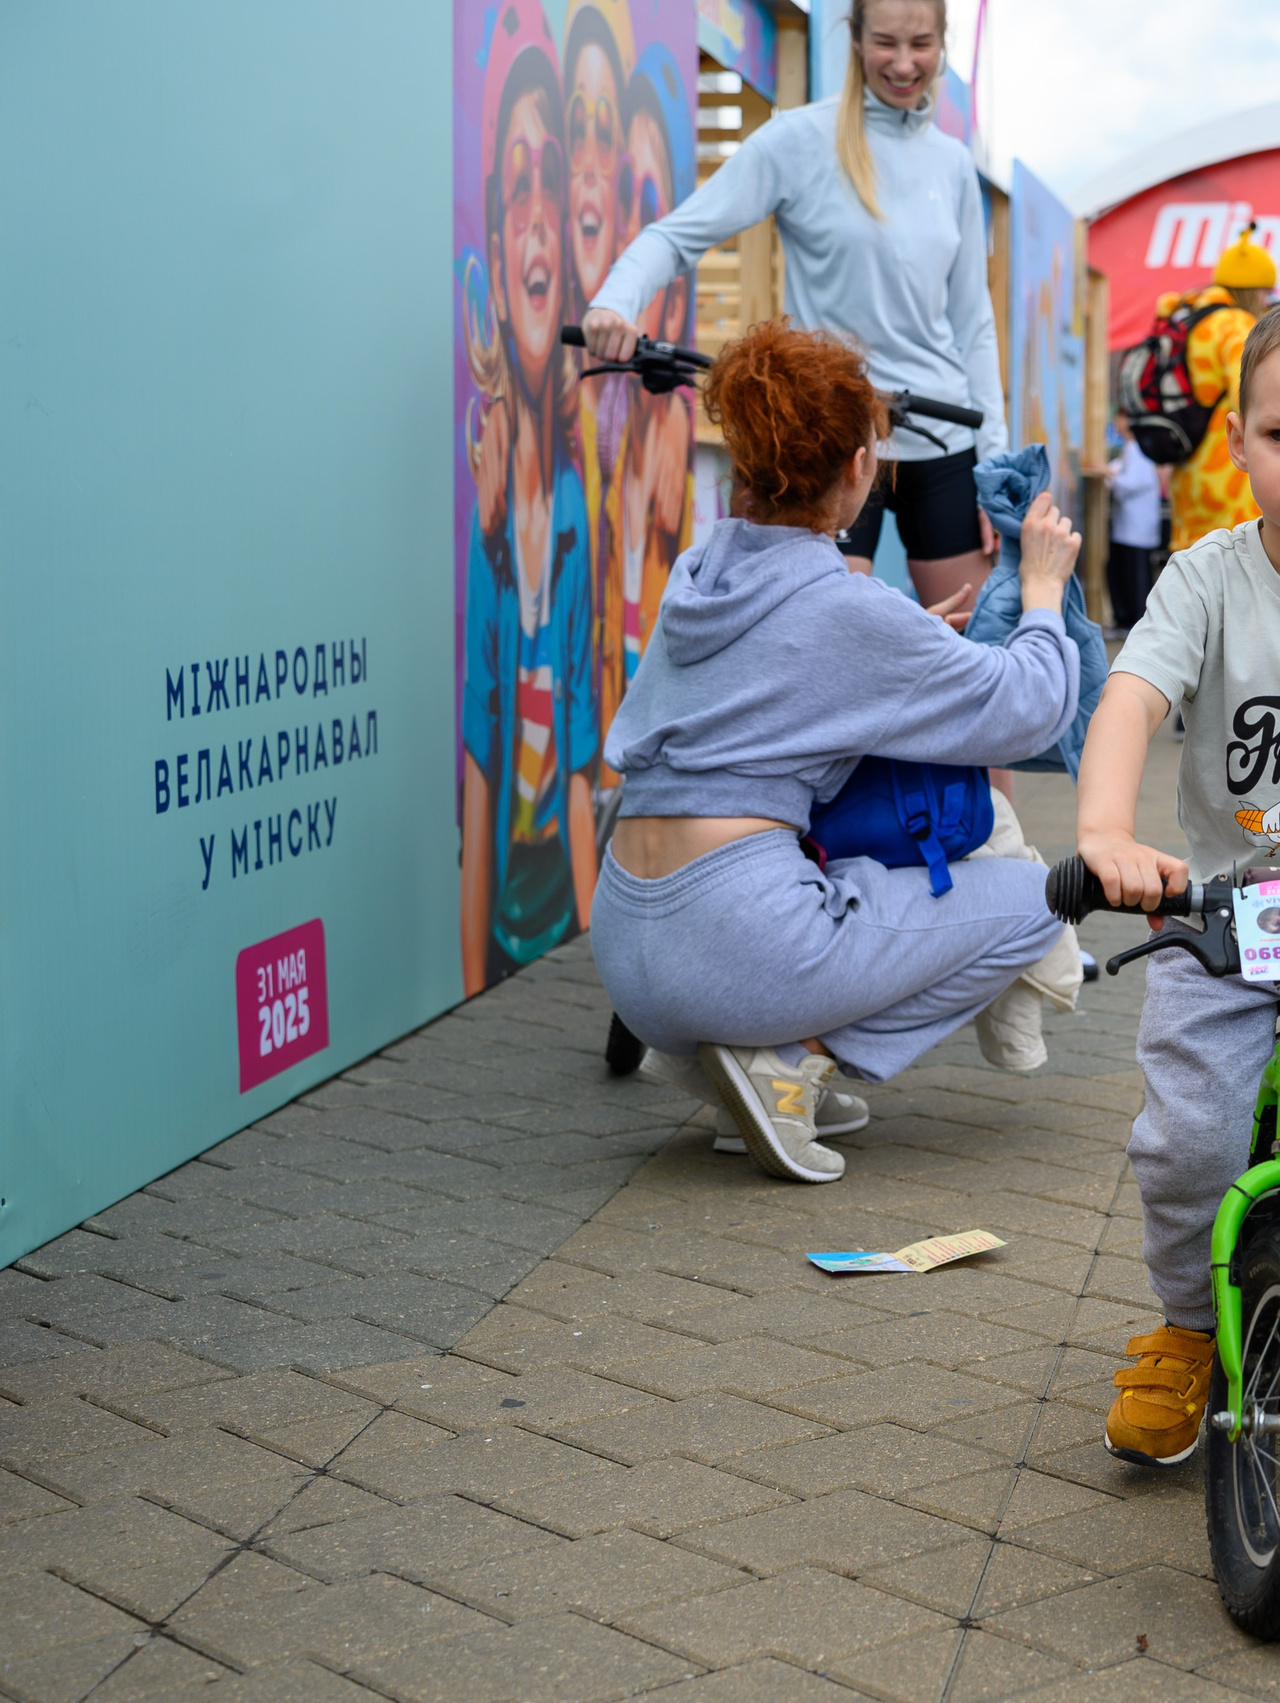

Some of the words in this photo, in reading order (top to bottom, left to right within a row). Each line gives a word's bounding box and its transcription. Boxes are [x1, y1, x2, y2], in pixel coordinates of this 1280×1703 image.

[166, 637, 367, 721] МІЖНАРОДНЫ
[155, 709, 379, 814] ВЕЛАКАРНАВАЛ
[199, 834, 215, 890] У
[230, 797, 337, 879] МІНСКУ
[256, 963, 275, 1002] 31
[277, 948, 307, 988] МАЯ
[258, 986, 311, 1057] 2025
